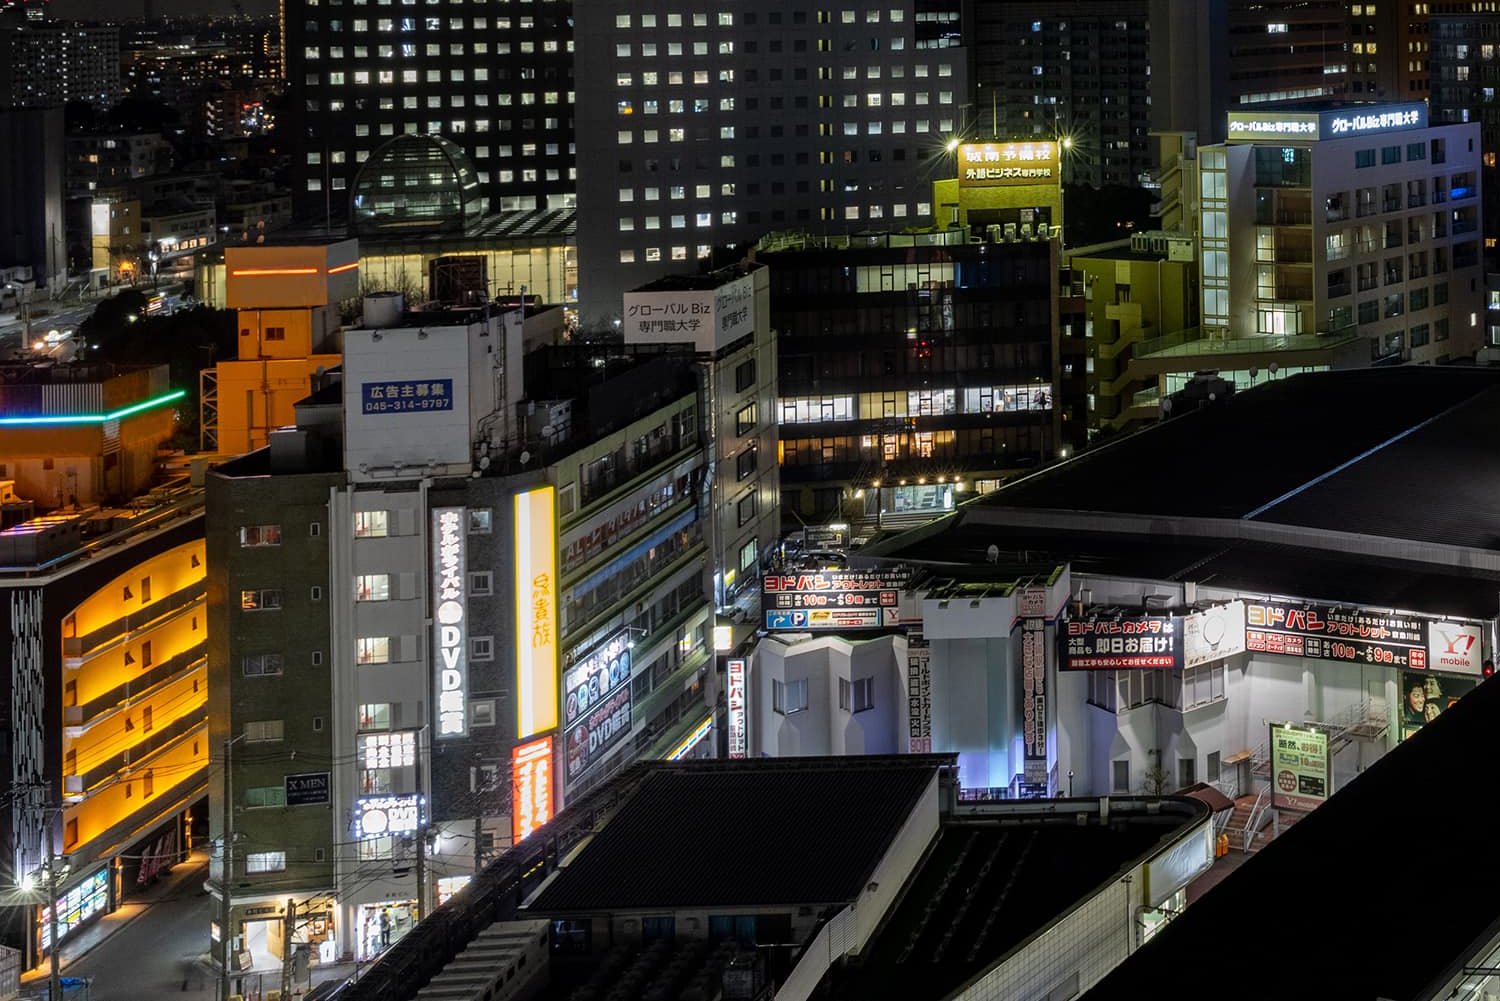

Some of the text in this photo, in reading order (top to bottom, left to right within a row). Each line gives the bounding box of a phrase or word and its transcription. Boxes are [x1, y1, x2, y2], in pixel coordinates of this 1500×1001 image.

[965, 168, 1052, 180] 外語ビジネス専門学校
[628, 303, 711, 317] グローバル Biz
[639, 319, 701, 333] 専門職大学
[370, 383, 445, 399] 広告主募集
[764, 575, 831, 591] ヨドバシ
[831, 580, 886, 590] アウトレット
[793, 612, 805, 625] P
[1248, 605, 1325, 630] ヨドバシ
[1068, 621, 1174, 635] ヨドバシカメラは
[1327, 621, 1391, 639] アウトレット
[1096, 636, 1174, 654] 即日お届け!
[1440, 657, 1471, 667] mobile
[730, 663, 743, 711] ヨドバシ
